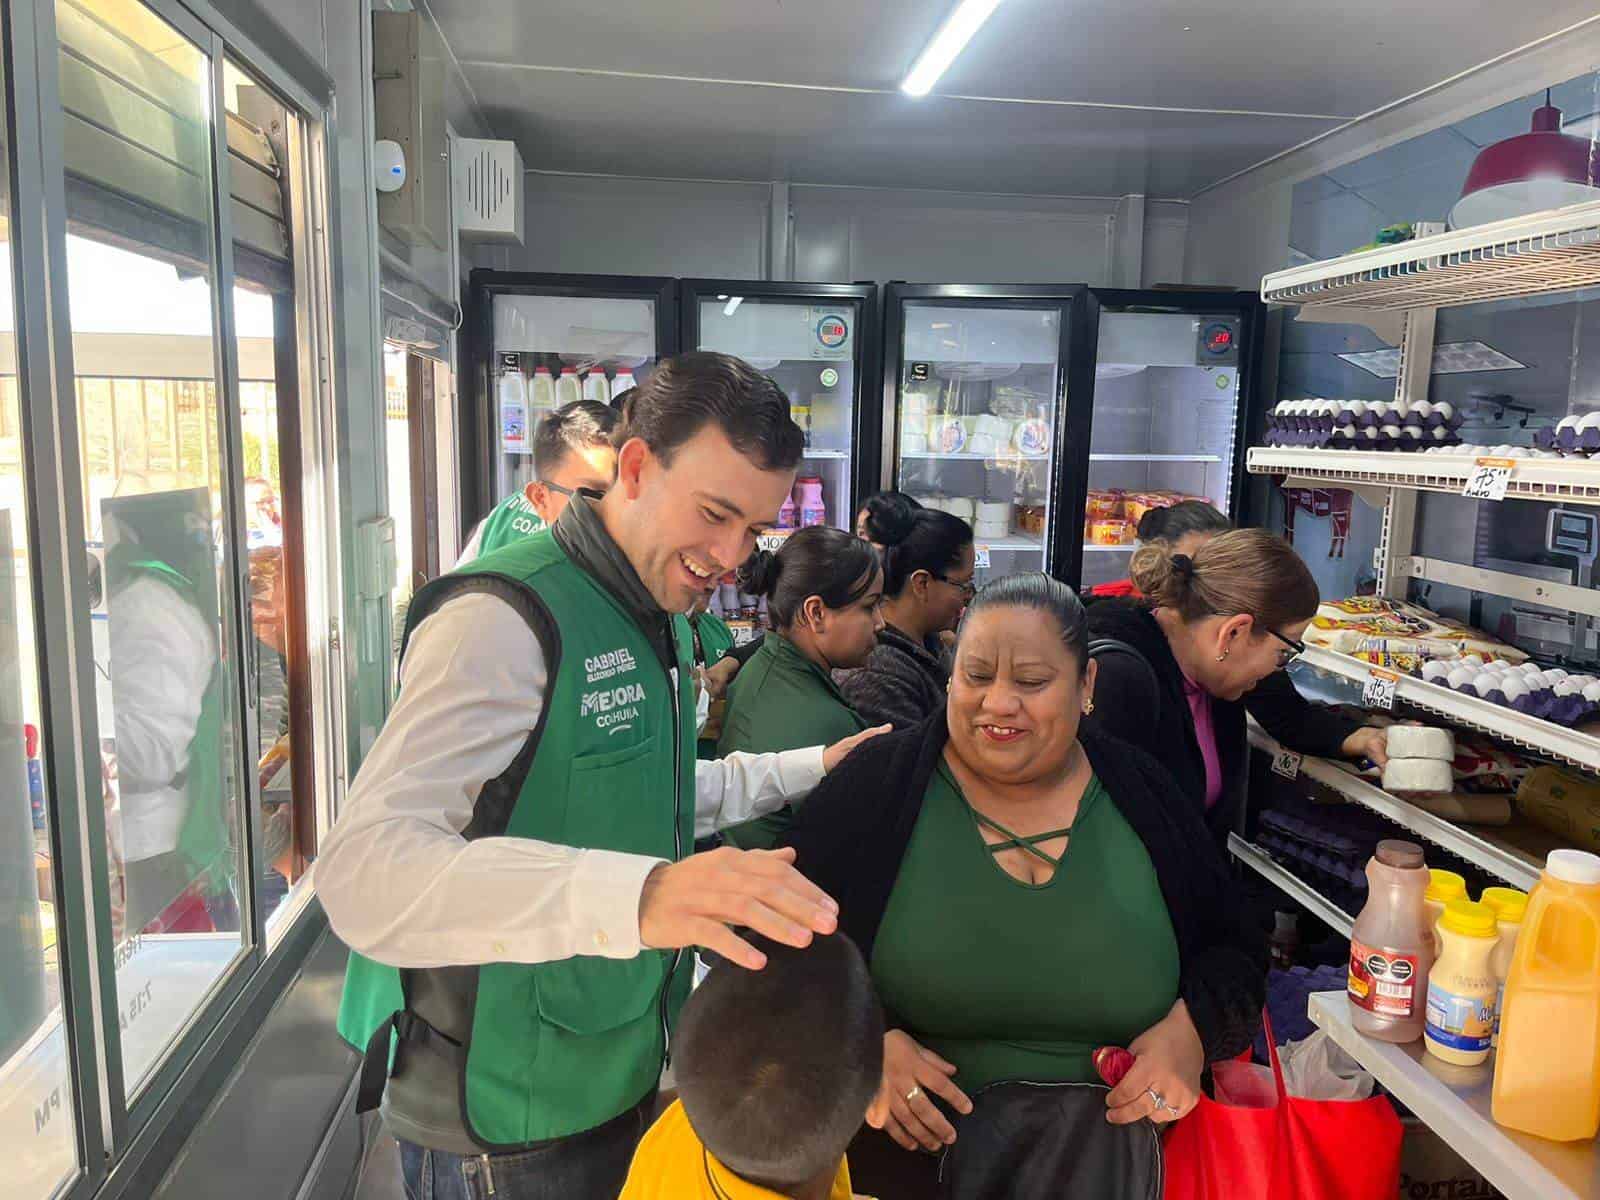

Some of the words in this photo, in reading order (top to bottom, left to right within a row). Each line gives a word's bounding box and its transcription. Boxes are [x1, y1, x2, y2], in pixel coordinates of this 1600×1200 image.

[584, 647, 634, 673] GABRIEL
[580, 683, 647, 717] MEJORA
[596, 707, 639, 728] COAHUILA
